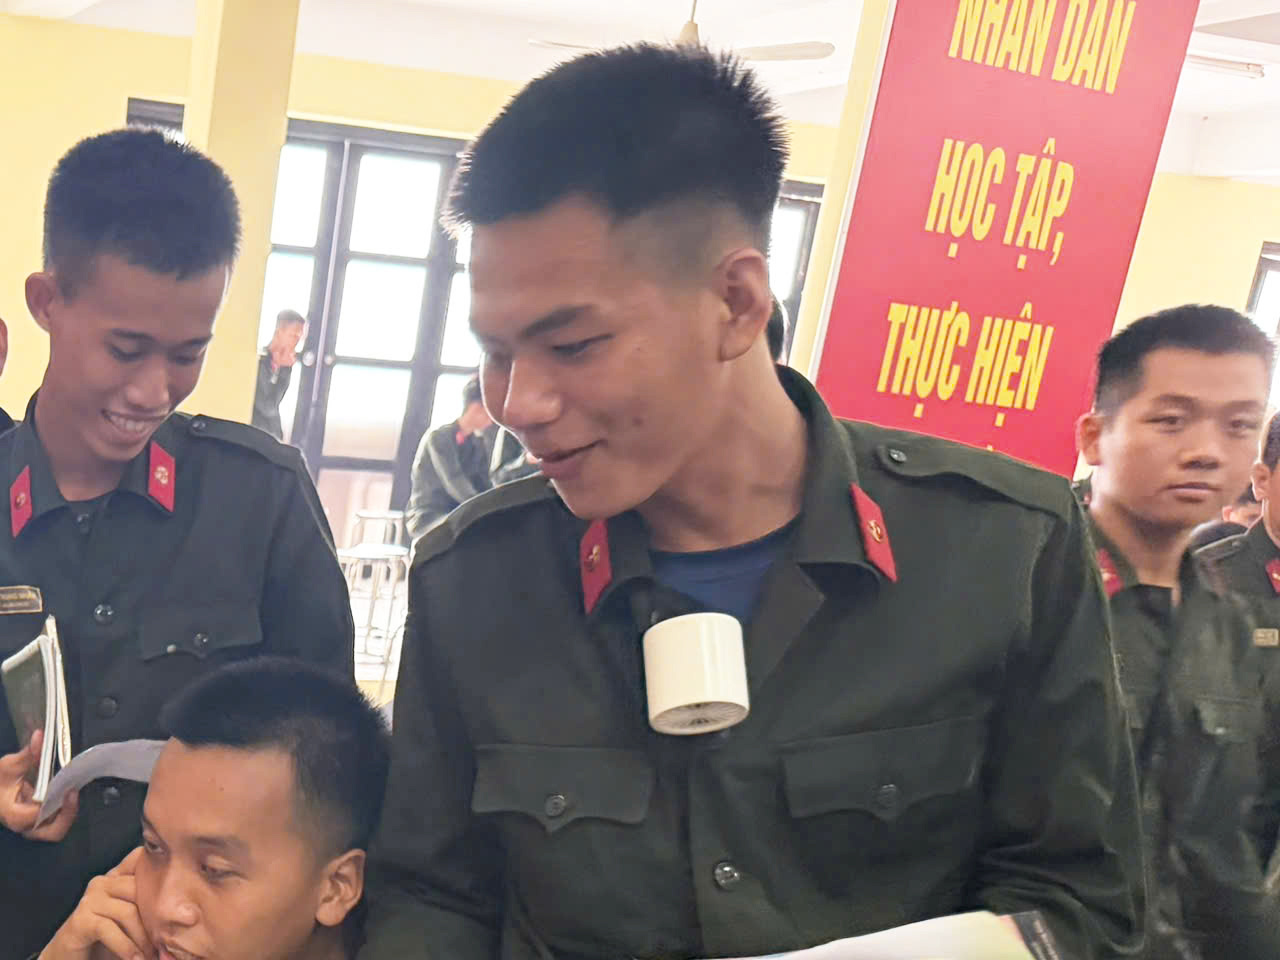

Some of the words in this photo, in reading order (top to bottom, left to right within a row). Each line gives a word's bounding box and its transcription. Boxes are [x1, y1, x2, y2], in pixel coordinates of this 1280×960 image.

[924, 138, 1006, 258] HỌC
[1003, 137, 1074, 269] TẬP,
[876, 300, 971, 418] THỰC
[964, 301, 1055, 427] HIỆN
